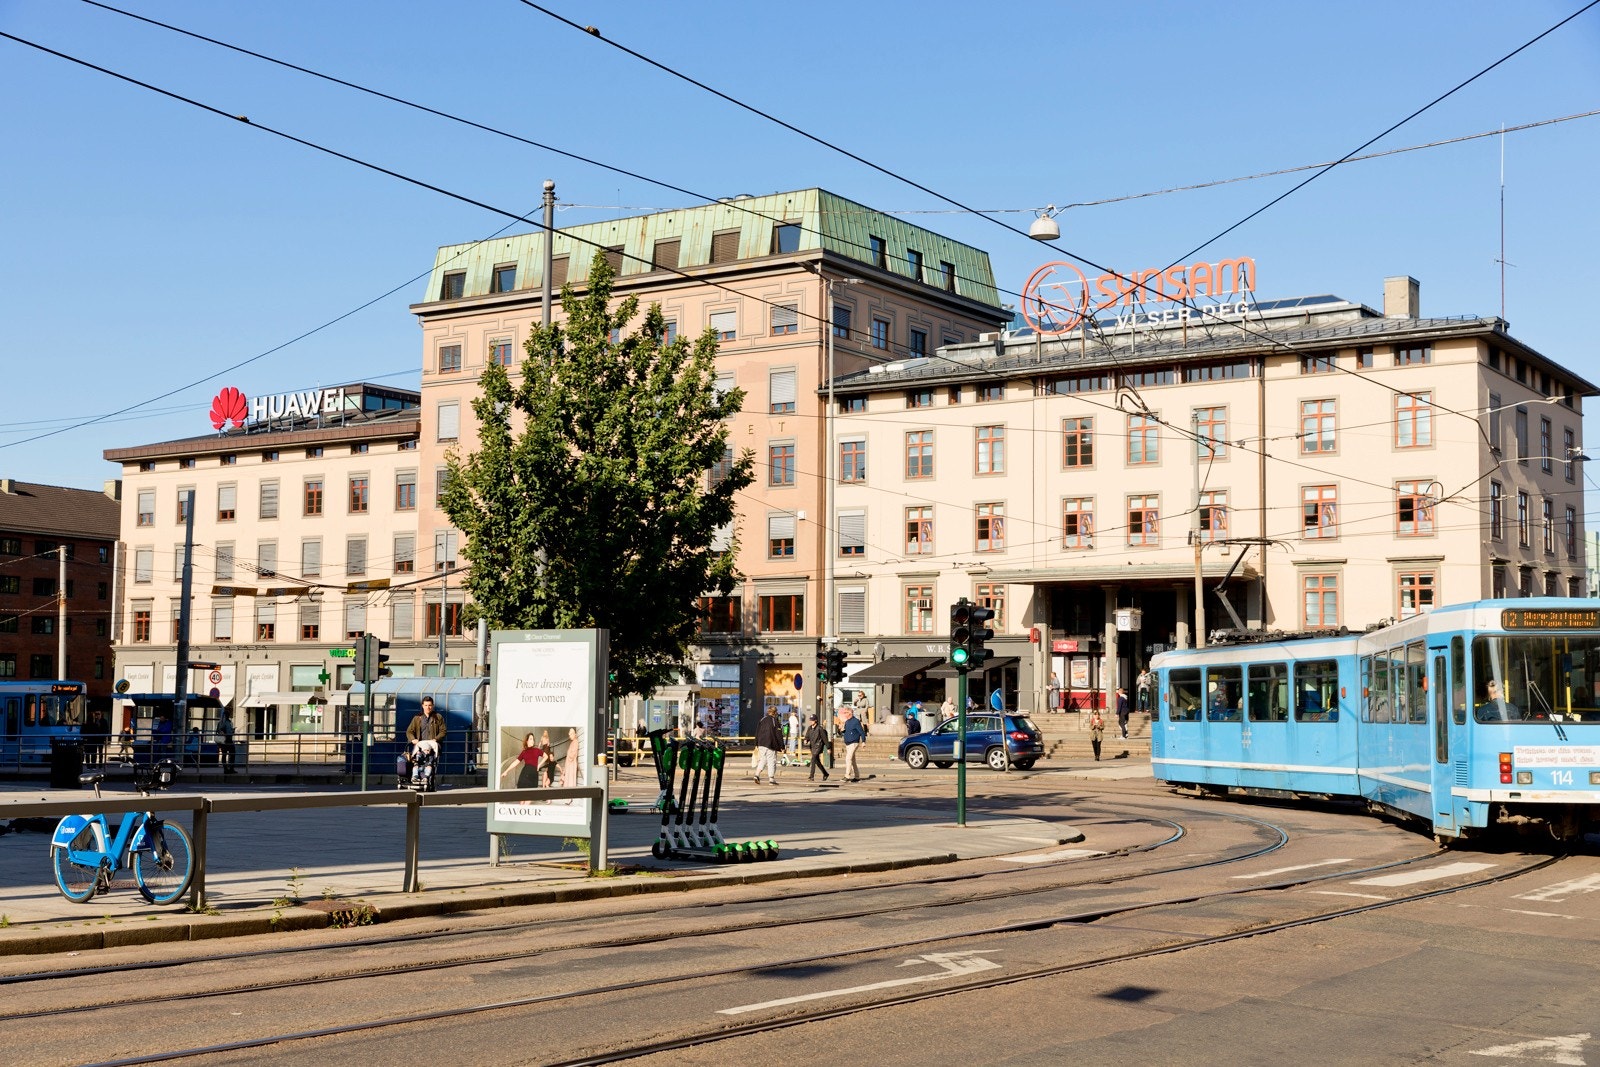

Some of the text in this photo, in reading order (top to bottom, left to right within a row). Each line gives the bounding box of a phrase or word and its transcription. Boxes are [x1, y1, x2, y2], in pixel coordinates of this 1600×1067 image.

[1116, 301, 1250, 330] VI SER DEG
[253, 388, 345, 420] HUAWEI
[1503, 611, 1517, 627] 12
[926, 645, 936, 653] W.
[515, 678, 572, 691] Power dressing
[521, 692, 566, 703] for women
[1550, 770, 1573, 785] 114
[498, 807, 542, 817] CAVOUR
